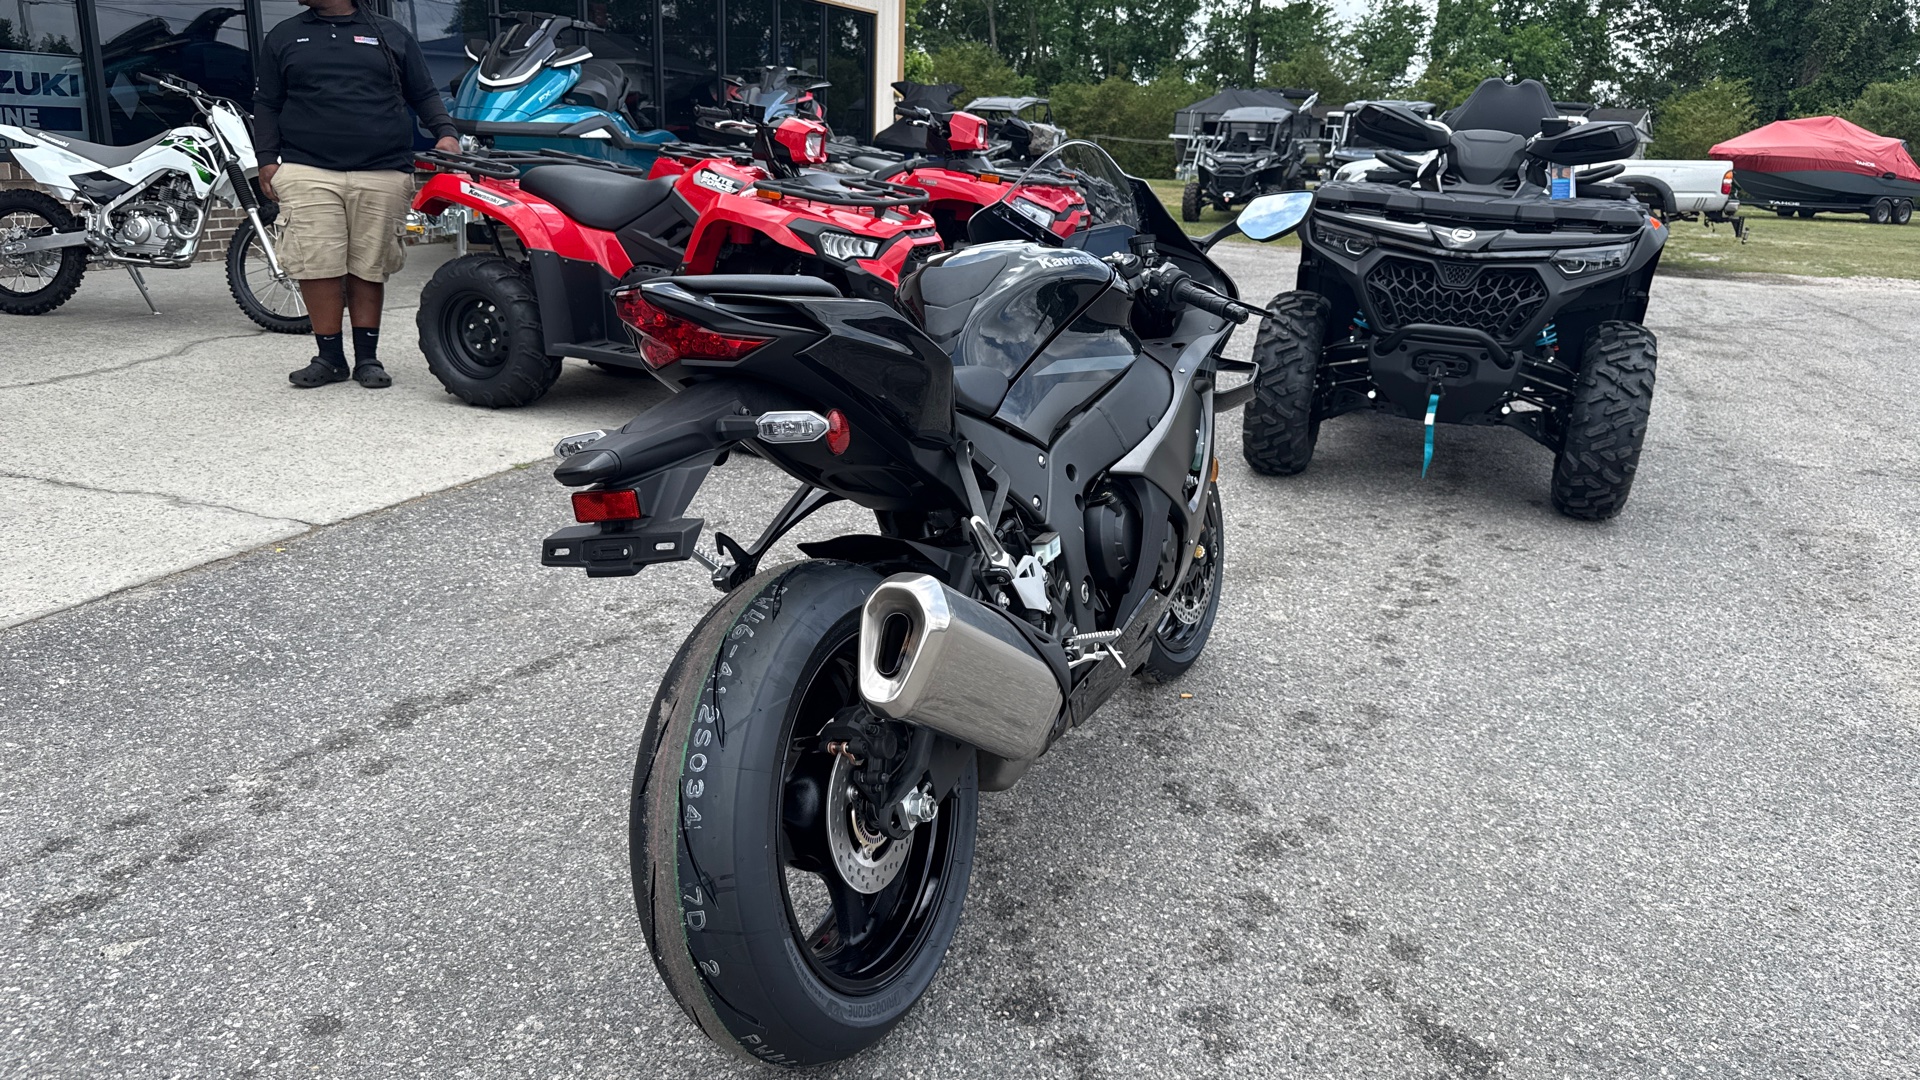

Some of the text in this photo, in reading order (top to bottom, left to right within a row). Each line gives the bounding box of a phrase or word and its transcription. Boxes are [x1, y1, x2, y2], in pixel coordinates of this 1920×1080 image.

[700, 179, 733, 193] FORCE
[701, 170, 735, 186] BRUTE
[468, 188, 501, 205] Kawasaki
